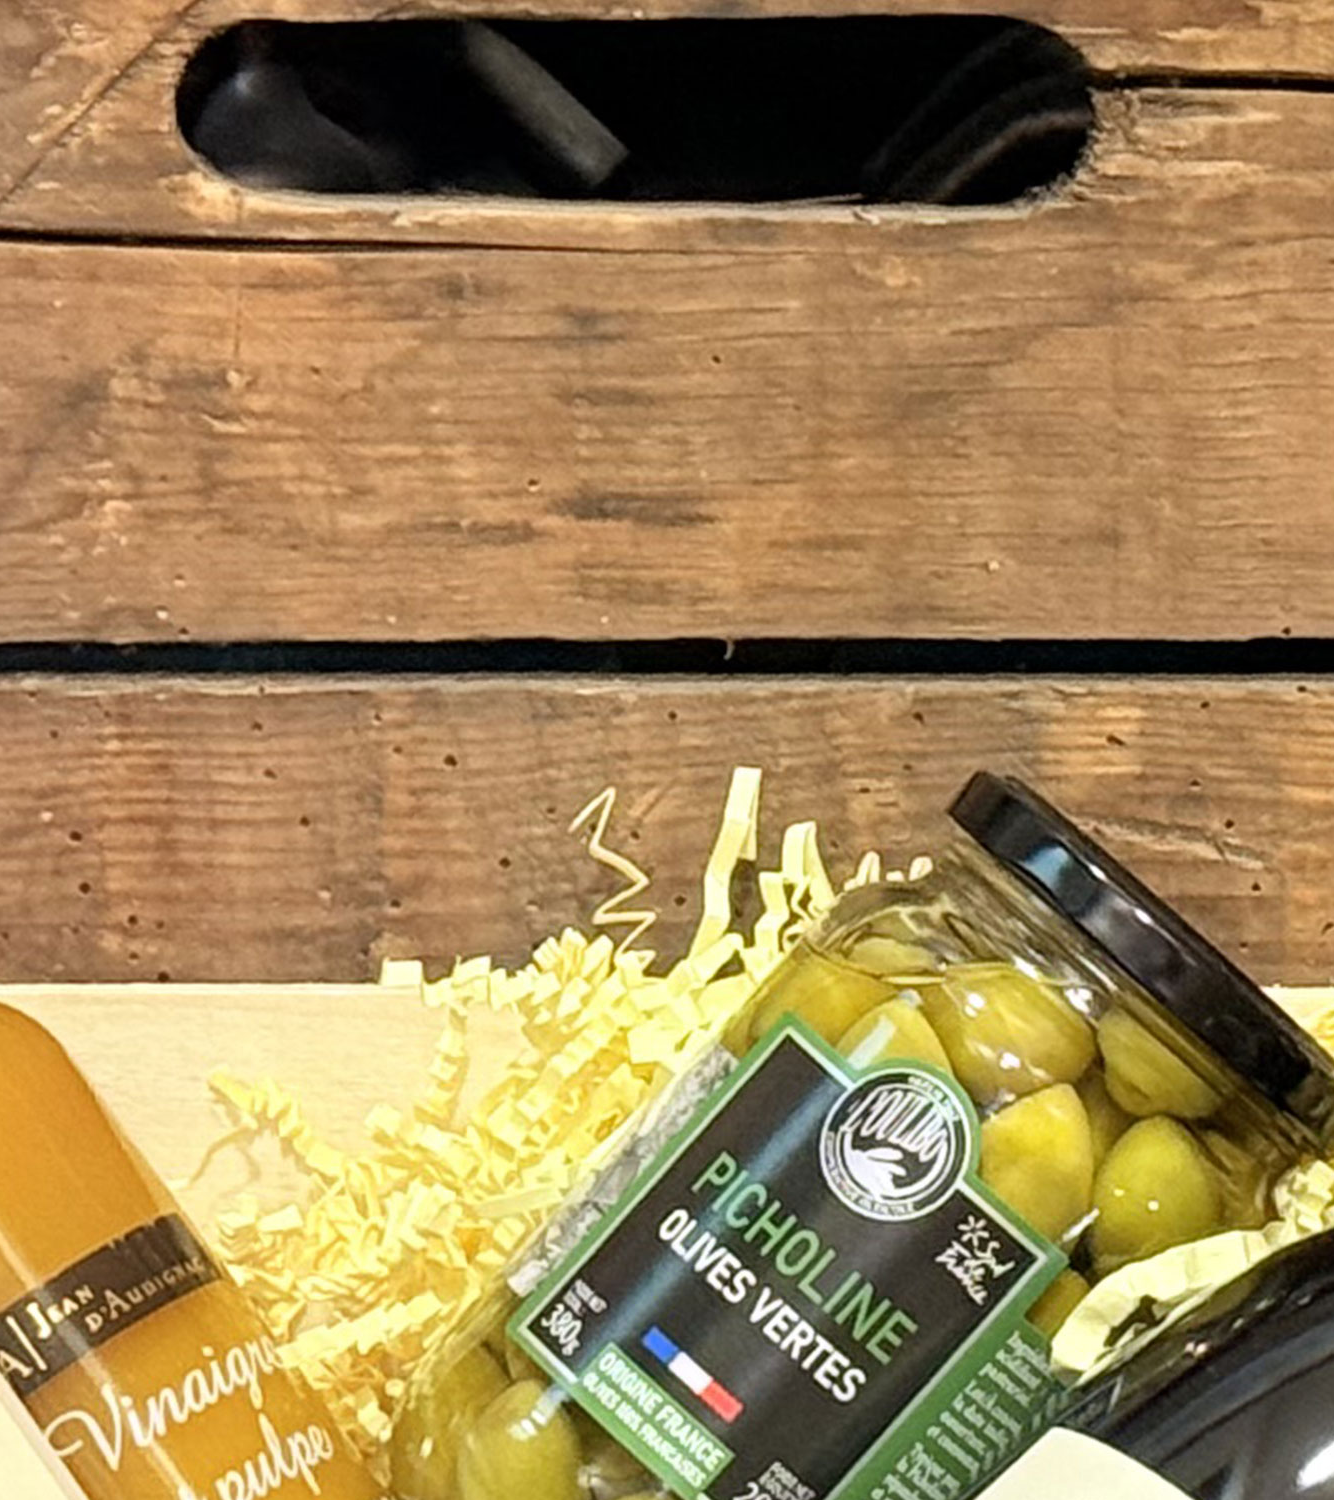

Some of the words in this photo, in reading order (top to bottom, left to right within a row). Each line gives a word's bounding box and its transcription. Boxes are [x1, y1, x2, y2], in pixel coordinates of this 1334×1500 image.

[657, 1208, 762, 1305] OLIVES
[748, 1287, 867, 1405] VERTES
[690, 1151, 919, 1367] PICHOLINE
[44, 1332, 279, 1471] Vinaigr
[599, 1352, 665, 1414] ORIGINE
[656, 1406, 724, 1471] FRANCE
